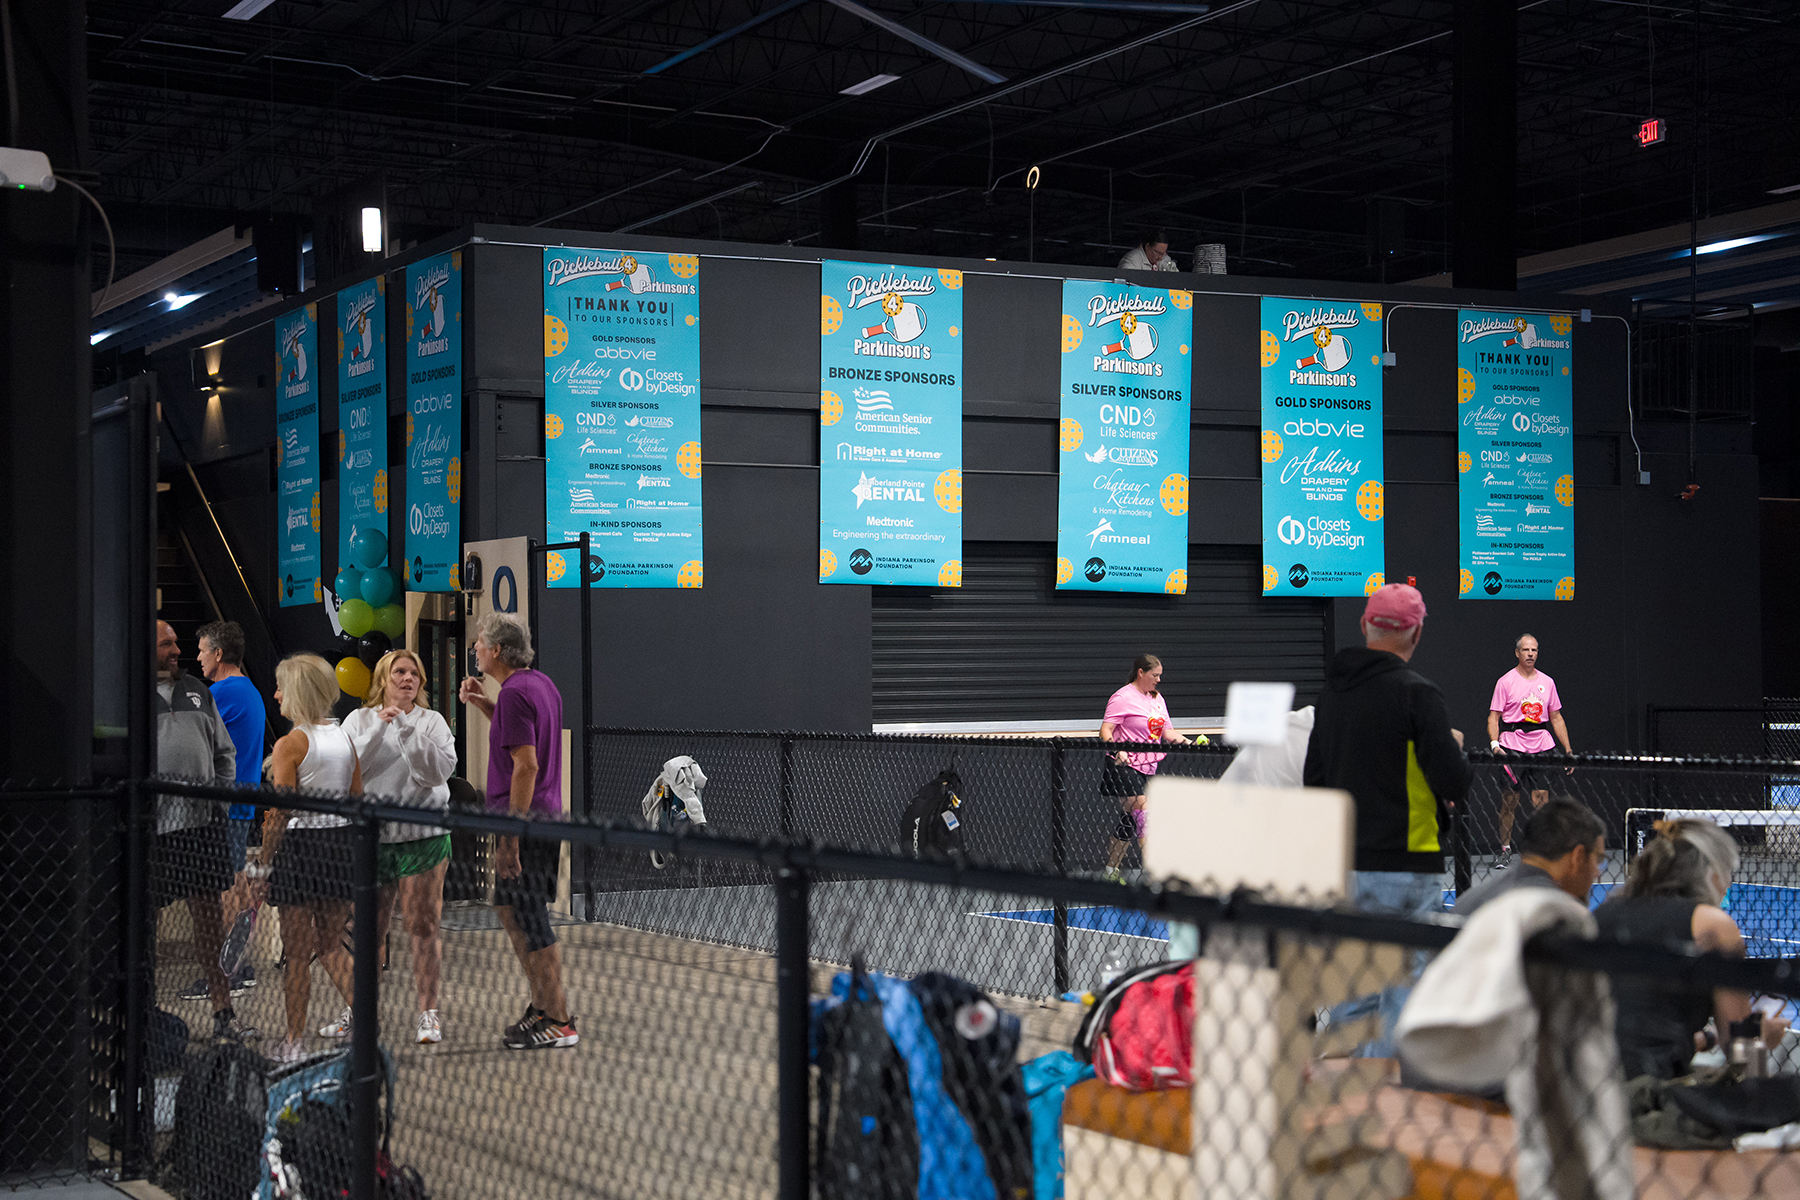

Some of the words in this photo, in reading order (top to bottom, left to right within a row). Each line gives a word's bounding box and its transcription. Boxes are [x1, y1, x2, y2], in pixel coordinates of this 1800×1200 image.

[1642, 120, 1658, 143] EXIT
[548, 256, 624, 286] Pickleball
[624, 258, 632, 270] 4
[415, 262, 450, 310] Pickleball
[640, 280, 696, 295] Parkinson's
[847, 273, 936, 309] Pickleball
[574, 297, 629, 312] THANK
[637, 301, 668, 314] YOU
[888, 296, 898, 312] 4
[1088, 293, 1167, 328] Pickleball
[592, 315, 611, 323] OUR
[617, 316, 668, 326] SPONSORS
[1124, 316, 1133, 331] 4
[1283, 308, 1359, 343] Pickleball
[1517, 319, 1523, 329] 4
[1318, 329, 1327, 344] 4
[1461, 317, 1517, 343] Pickleball
[418, 336, 448, 357] Parkinson's
[615, 336, 656, 344] SPONSORS
[1529, 336, 1570, 349] Parkinson's
[595, 347, 656, 360] abbvie
[854, 339, 931, 360] Parkinson's
[1094, 356, 1163, 376] Parkinson's
[1480, 352, 1520, 365] THANK
[1526, 355, 1549, 366] YOU
[411, 371, 426, 384] GOLD
[428, 365, 455, 381] SPONSORS
[552, 360, 612, 383] Adkins
[646, 369, 683, 382] Closets
[829, 367, 882, 381] BRONZE
[885, 370, 955, 386] SPONSORS
[1290, 370, 1356, 387] Parkinson's
[646, 381, 695, 396] byDesign
[1072, 383, 1116, 396] SILVER
[1119, 386, 1182, 401] SPONSORS
[414, 391, 452, 414] abbvie
[1276, 397, 1307, 408] GOLD
[1310, 398, 1371, 410] SPONSORS
[1494, 394, 1540, 406] abbvie
[576, 413, 606, 425] CND
[855, 411, 900, 422] American
[903, 413, 932, 424] Senior
[1100, 404, 1141, 426] CND
[1464, 406, 1507, 426] Adkins
[1532, 413, 1560, 423] Closets
[1100, 426, 1116, 437] Life
[1119, 427, 1156, 440] Sciences
[1284, 418, 1364, 438] abbvie
[1532, 423, 1569, 436] byDesign
[412, 424, 450, 468] Adkins
[854, 446, 886, 457] Right
[906, 449, 941, 458] Home
[1109, 447, 1158, 465] CITIZENS
[1481, 451, 1502, 461] CND
[1280, 446, 1361, 484] Adkins
[1093, 468, 1141, 493] Chateau
[1107, 483, 1154, 508] Kitchens
[423, 502, 444, 518] Closets
[1118, 508, 1152, 518] Remodeling
[867, 516, 914, 527] Medtronic
[1307, 516, 1350, 532] Closets
[833, 529, 879, 541] Engineering
[882, 531, 894, 540] the
[896, 532, 946, 542] extraordinary
[1099, 535, 1150, 544] amneal
[1308, 532, 1364, 550] byDesign
[1637, 830, 1646, 856] PICKL
